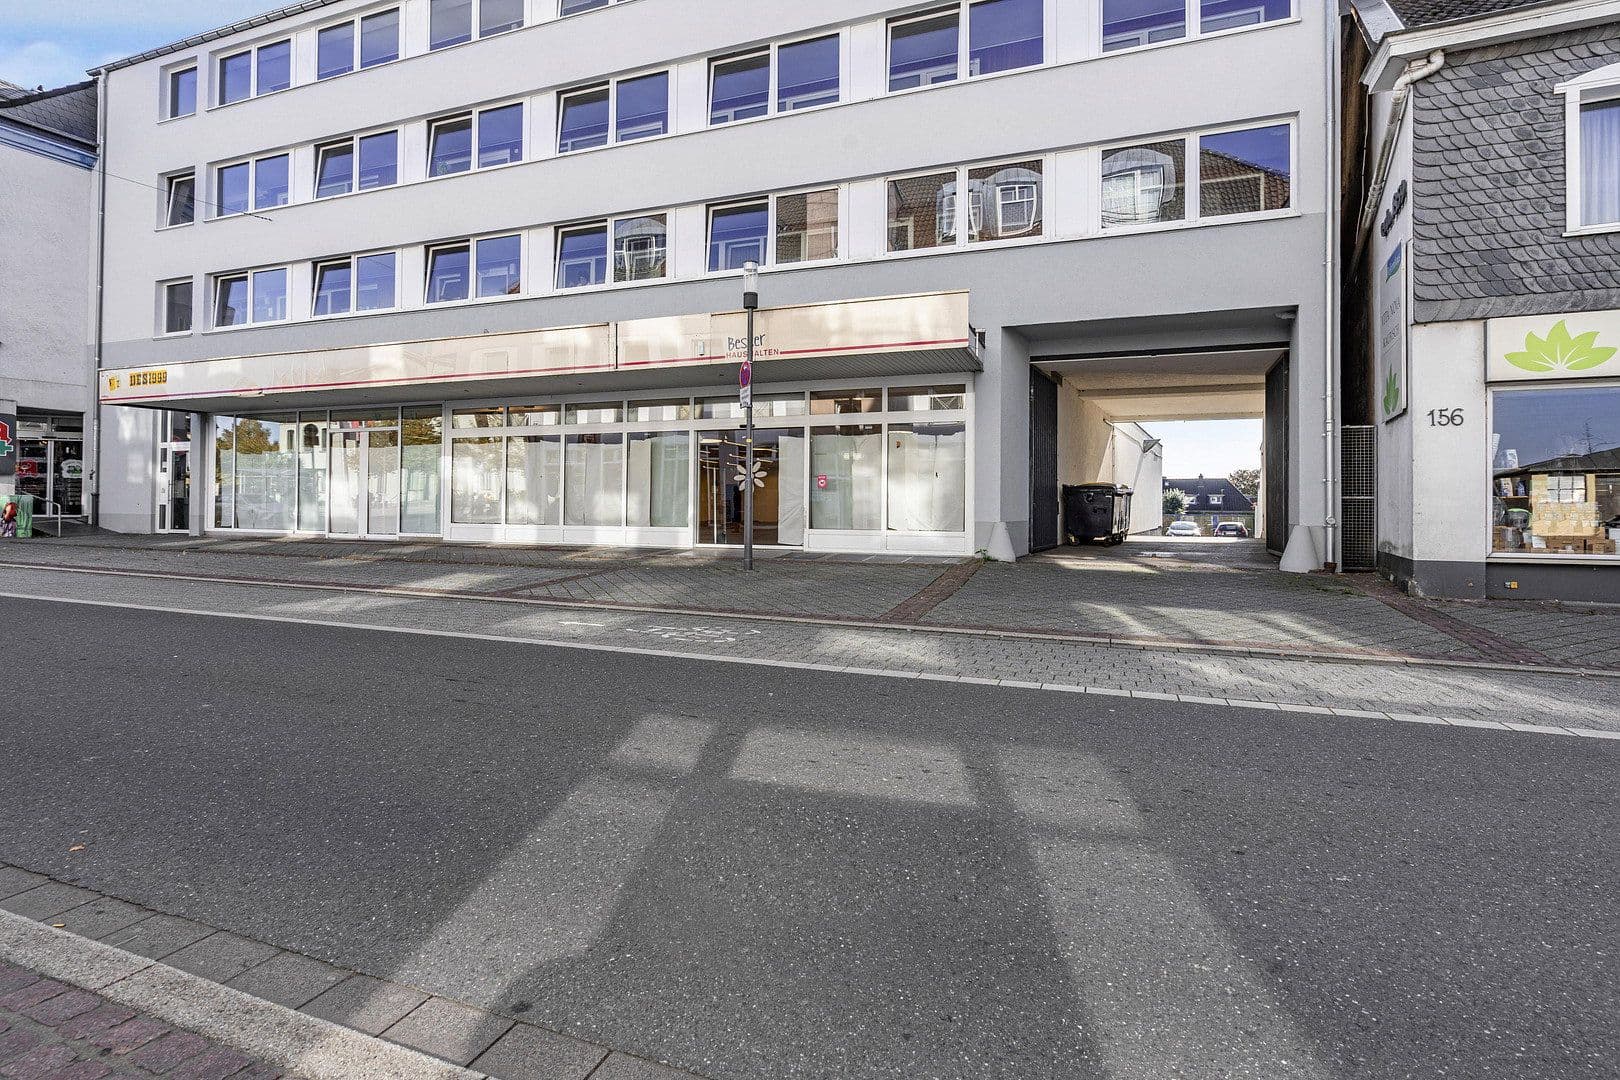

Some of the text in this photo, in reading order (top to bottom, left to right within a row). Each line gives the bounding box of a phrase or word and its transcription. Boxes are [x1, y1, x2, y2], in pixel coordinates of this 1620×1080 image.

[727, 333, 766, 351] Beser
[725, 348, 779, 359] HAUSALTEN
[1427, 407, 1464, 426] 156
